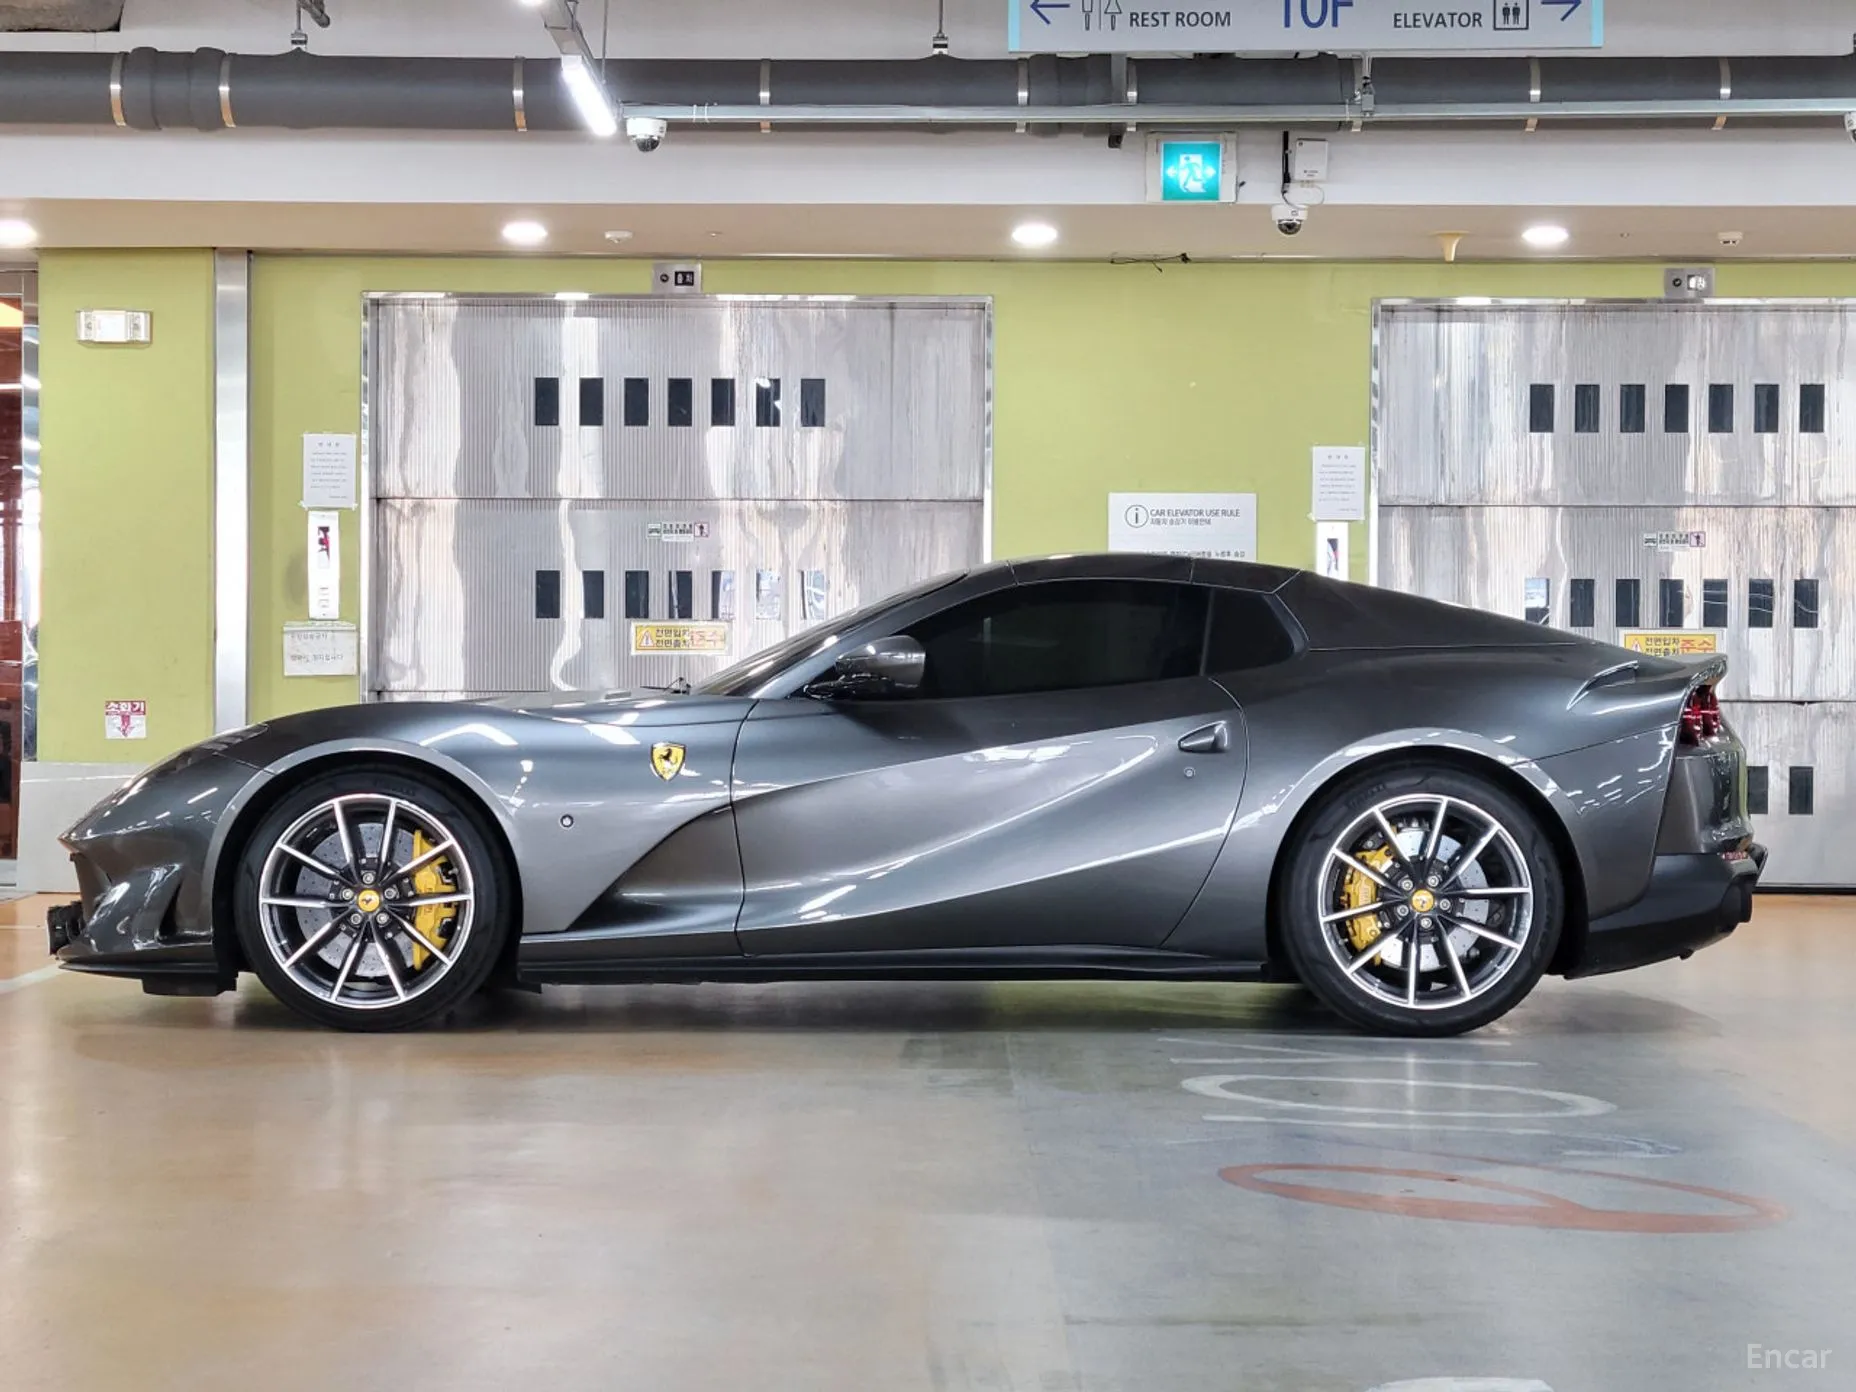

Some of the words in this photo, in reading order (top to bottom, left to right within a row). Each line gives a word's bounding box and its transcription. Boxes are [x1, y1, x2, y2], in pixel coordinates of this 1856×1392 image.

[1129, 11, 1170, 27] REST
[1175, 11, 1231, 27] ROOM
[1393, 13, 1482, 28] ELEVATOR
[1150, 509, 1166, 517] CAR
[1167, 509, 1205, 517] ELEVATOR
[1205, 509, 1220, 517] USE
[1221, 509, 1240, 517] RULE
[1645, 637, 1680, 646] 전면입차
